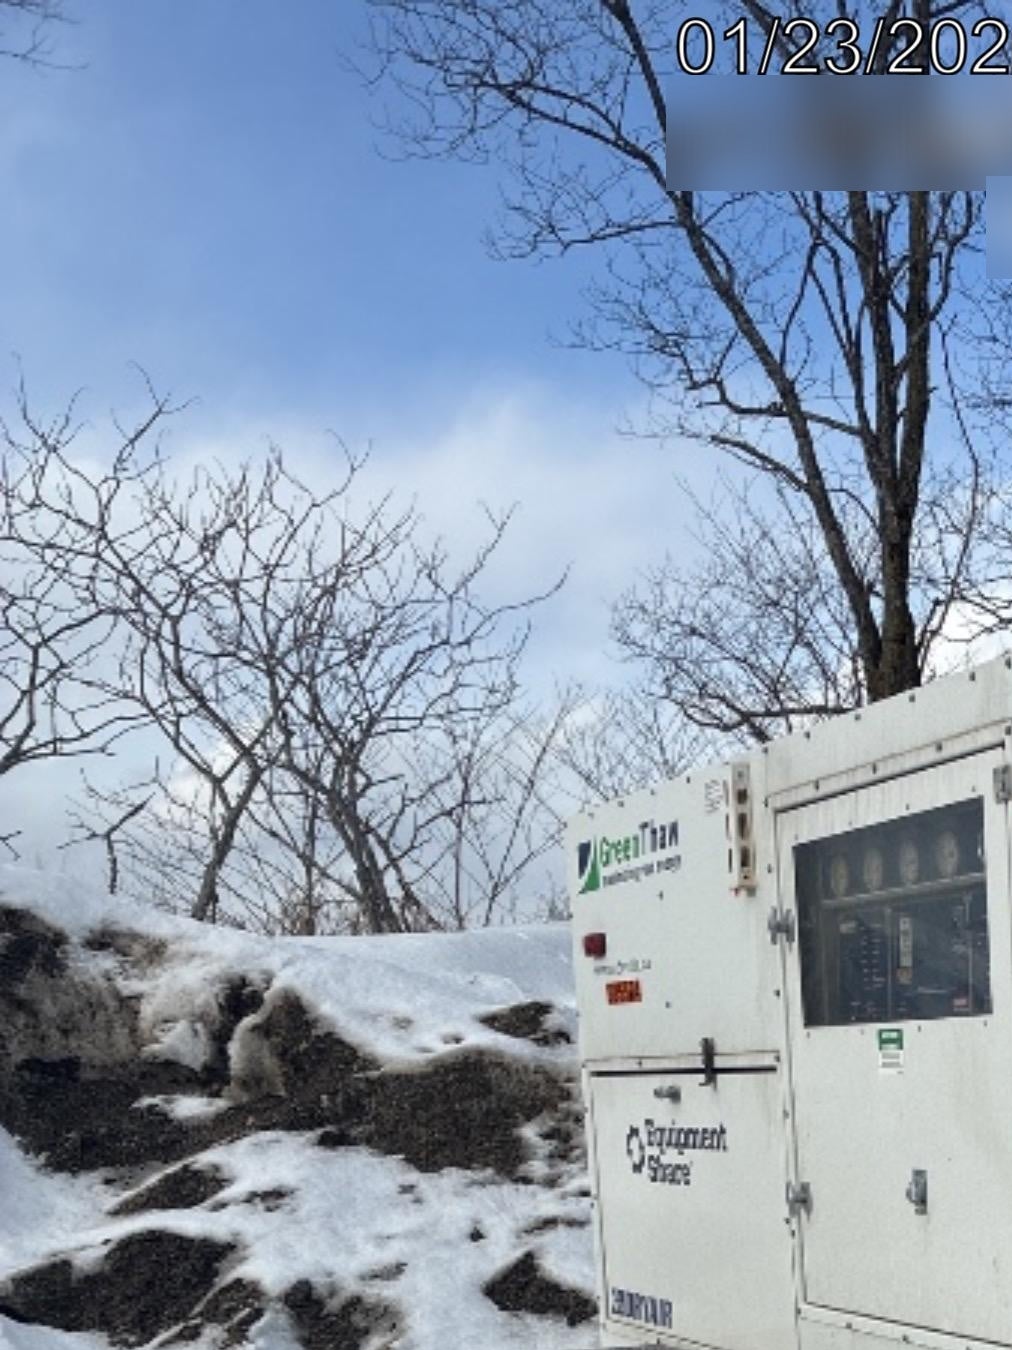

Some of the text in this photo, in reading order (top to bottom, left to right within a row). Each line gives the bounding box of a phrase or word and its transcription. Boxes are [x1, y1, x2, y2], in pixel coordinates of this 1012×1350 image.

[601, 821, 679, 867] GreenThaw
[644, 1119, 727, 1155] Equipment
[648, 1154, 691, 1185] Share
